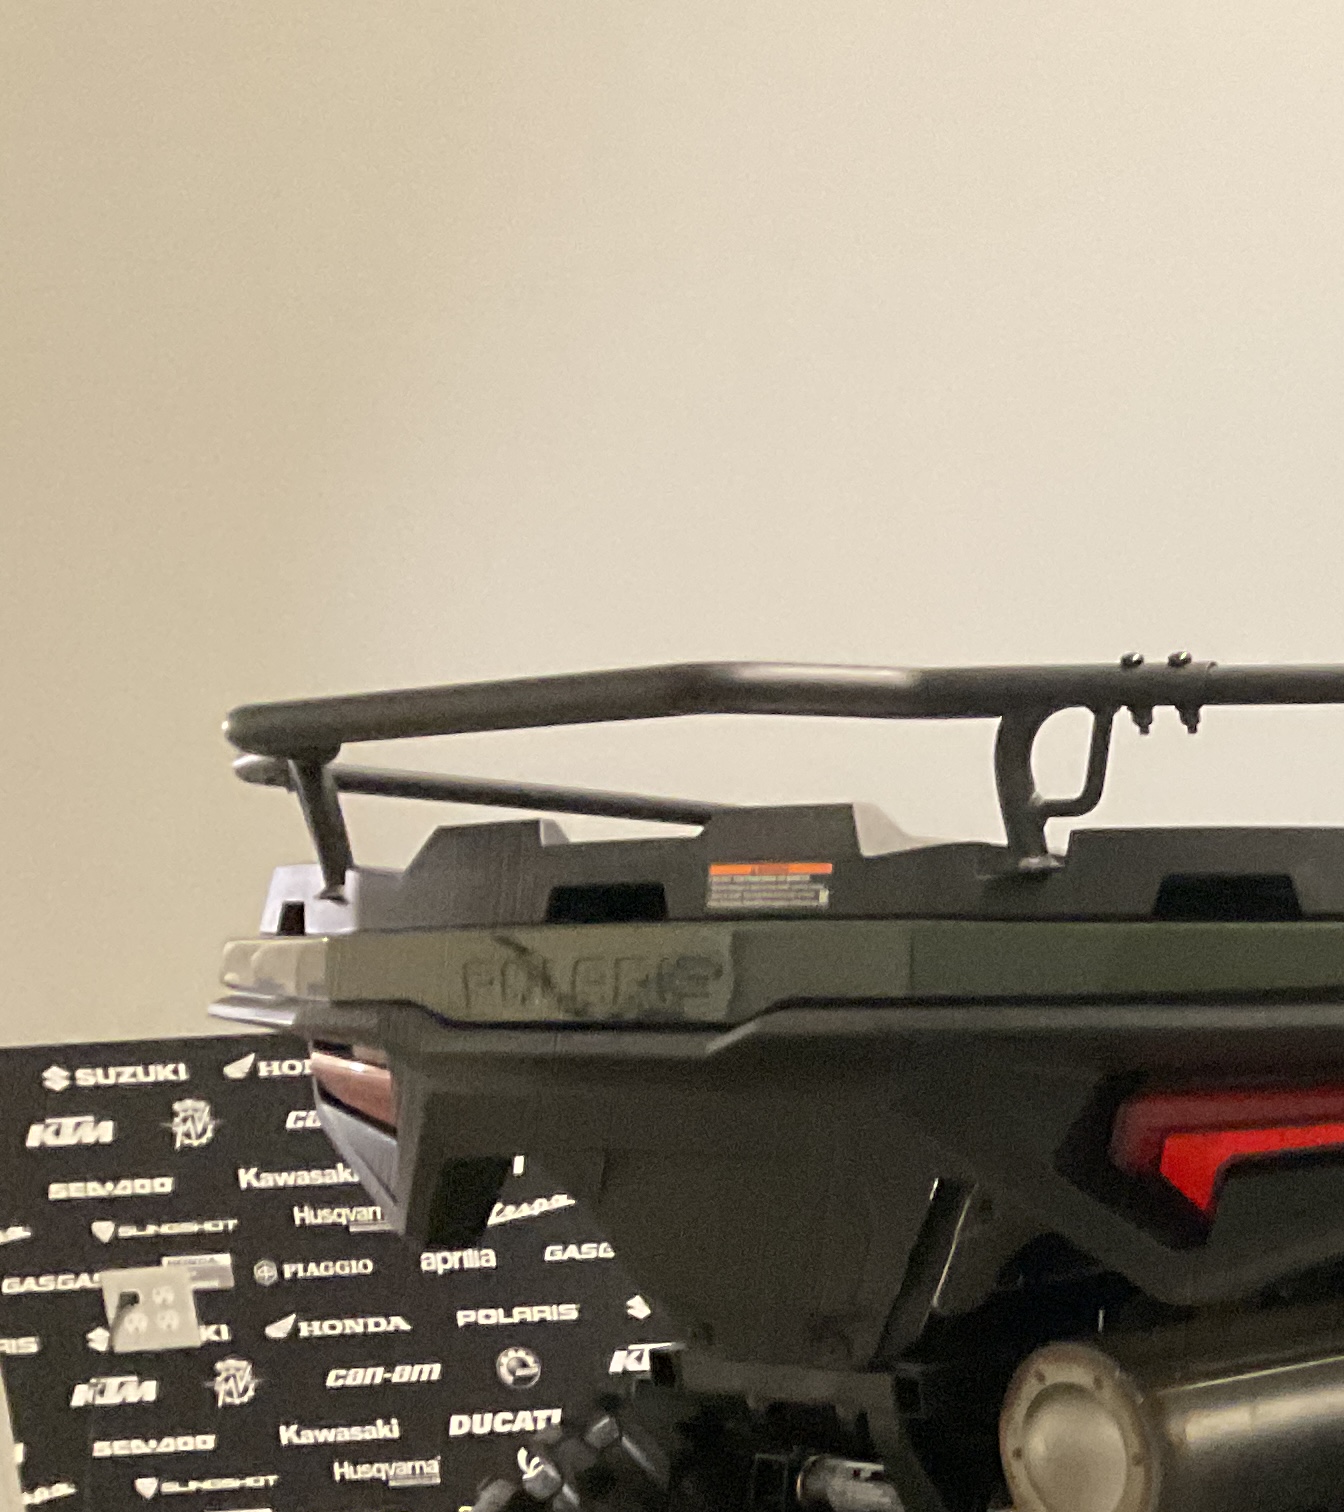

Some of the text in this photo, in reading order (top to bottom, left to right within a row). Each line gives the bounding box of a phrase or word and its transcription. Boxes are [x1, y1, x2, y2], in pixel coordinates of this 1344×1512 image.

[75, 1062, 190, 1087] SUZUKI
[26, 1115, 115, 1148] KTM
[238, 1162, 360, 1191] Kawasak
[117, 1219, 238, 1238] SLINGSHOT
[282, 1259, 373, 1280] PIAGGIO
[420, 1248, 496, 1275] aprilia
[299, 1316, 413, 1338] HONDA
[456, 1304, 579, 1328] POLARIS
[326, 1363, 441, 1388] can-am
[70, 1375, 159, 1408] KTM
[279, 1418, 400, 1446] Kawasaki
[449, 1408, 562, 1437] DUCATI
